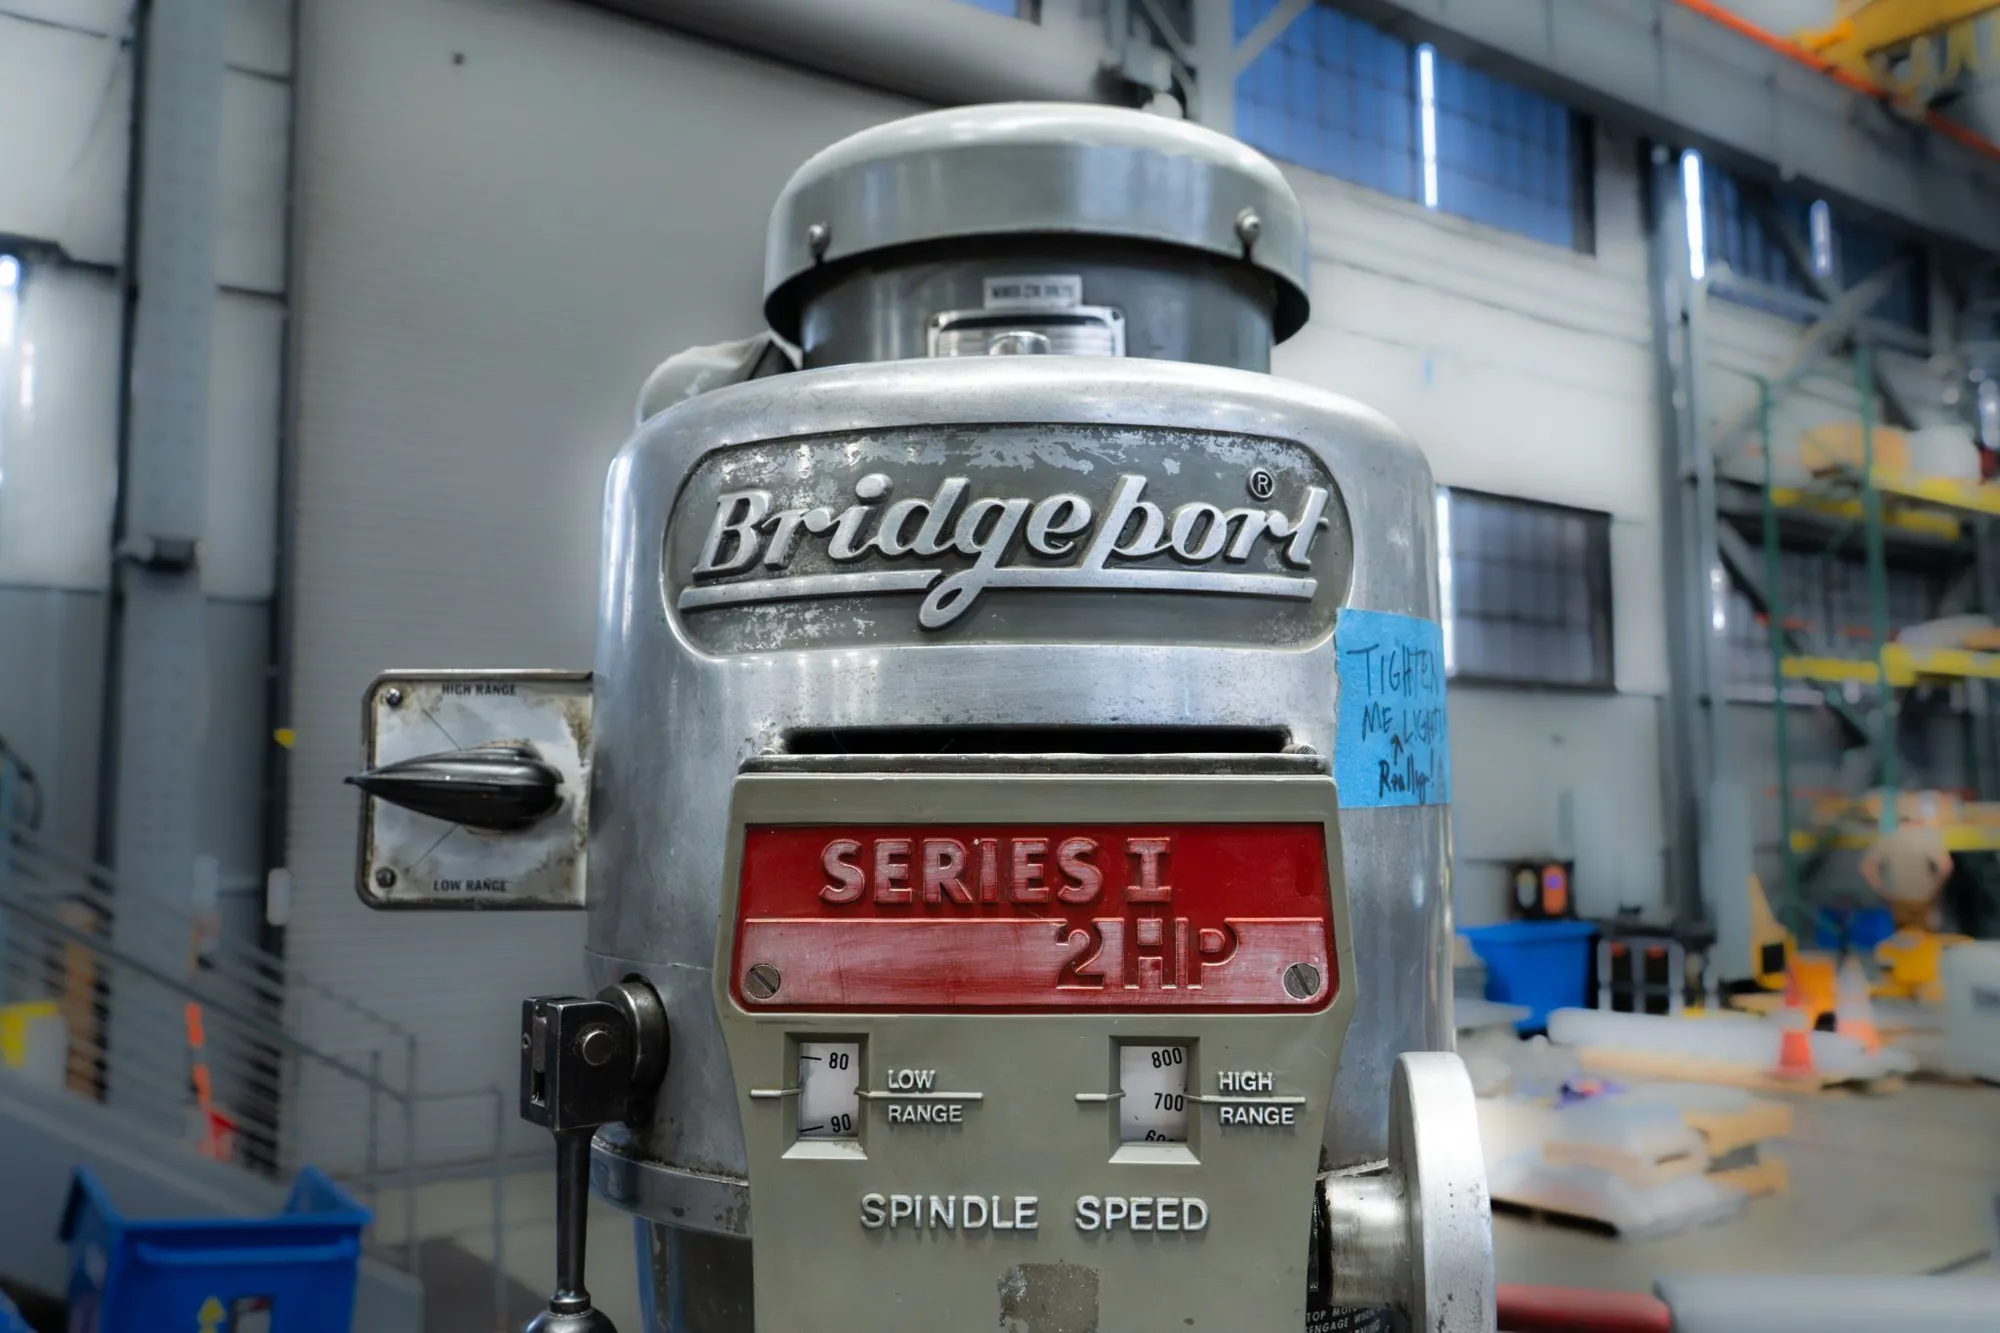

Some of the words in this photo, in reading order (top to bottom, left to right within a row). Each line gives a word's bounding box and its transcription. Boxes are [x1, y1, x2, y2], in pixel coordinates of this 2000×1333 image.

[688, 473, 1330, 630] Bridgeport
[442, 684, 471, 696] HIGH
[476, 684, 516, 696] RANGE
[1361, 701, 1393, 742] ME
[818, 836, 1103, 903] SERIES
[1125, 836, 1173, 903] I
[433, 880, 463, 892] LOW
[466, 880, 507, 893] RANGE
[829, 1052, 849, 1070] 80
[1151, 1047, 1183, 1068] 800
[888, 1069, 935, 1089] LOW
[1218, 1071, 1273, 1091] HIGH
[1154, 1092, 1184, 1112] 700
[831, 1114, 851, 1133] 90
[888, 1104, 963, 1123] RANGE
[1219, 1107, 1295, 1125] RANGE
[860, 1192, 1039, 1229] SPINDLE
[1075, 1195, 1210, 1231] SPEED
[1306, 1309, 1327, 1323] TOP
